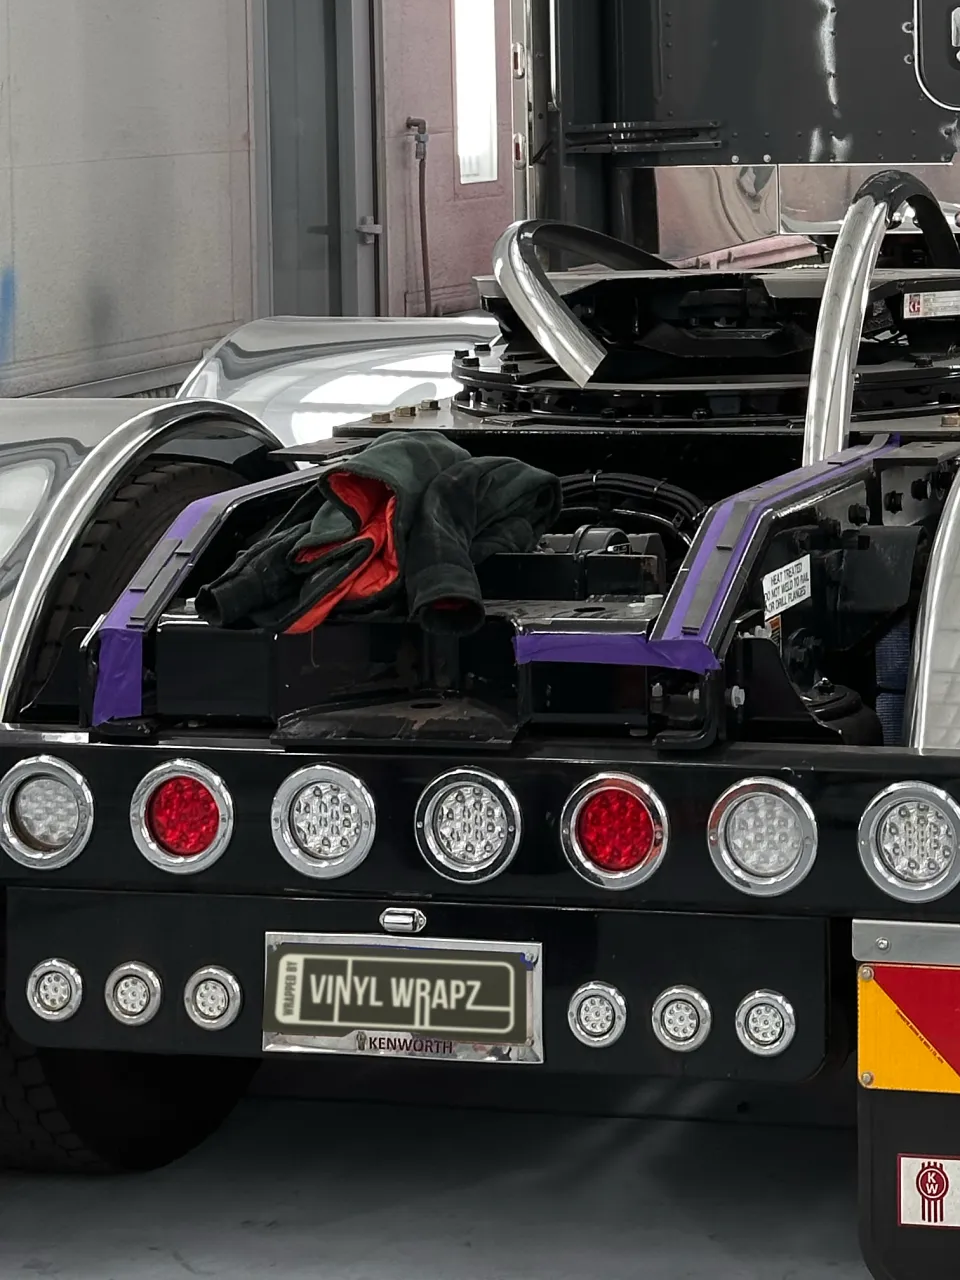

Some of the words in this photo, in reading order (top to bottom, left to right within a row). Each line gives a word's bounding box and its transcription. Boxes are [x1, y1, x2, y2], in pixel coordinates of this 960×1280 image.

[771, 572, 783, 586] HEAT
[784, 563, 802, 578] TREATED
[368, 1036, 454, 1054] KENWORTH
